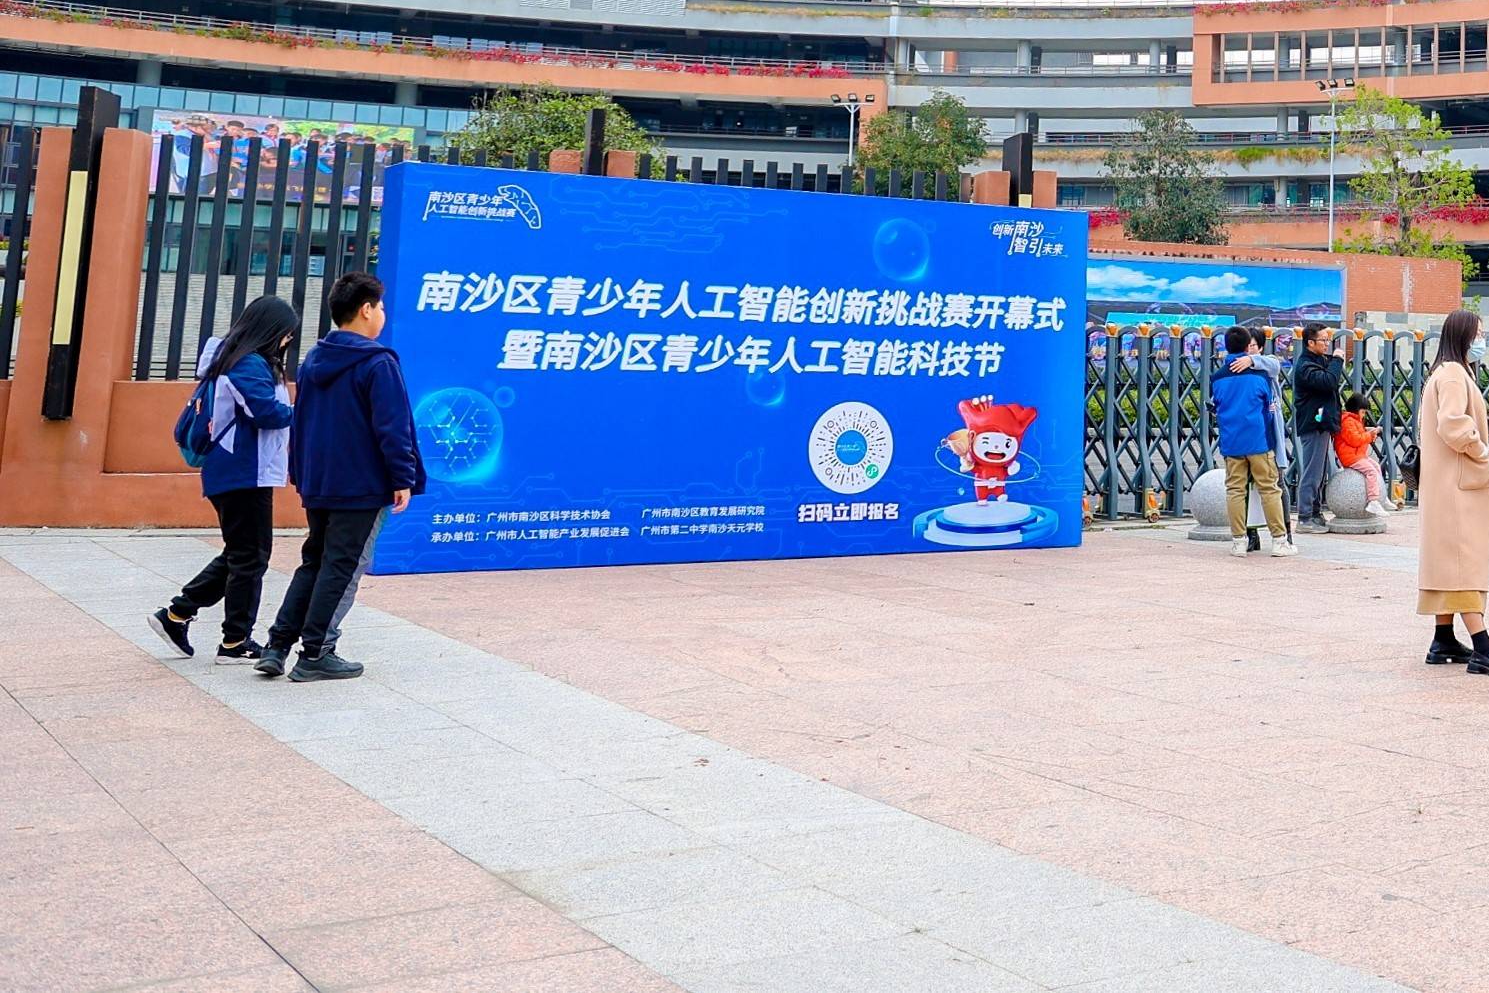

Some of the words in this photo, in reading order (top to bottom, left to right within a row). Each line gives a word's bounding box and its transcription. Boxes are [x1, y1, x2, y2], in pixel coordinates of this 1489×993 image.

[427, 191, 503, 206] 南沙区青少年
[428, 204, 517, 218] 人工智能创新挑战赛
[417, 270, 1067, 332] 南沙区青少年人工智能创新挑战赛开幕式
[496, 329, 1005, 379] 暨南沙区青少年人工智能科技节
[641, 504, 766, 519] 广州市南沙区教育发展研究院
[797, 502, 900, 523] 扫码立即报名
[640, 522, 765, 537] 广州市第二中学南沙天元学校
